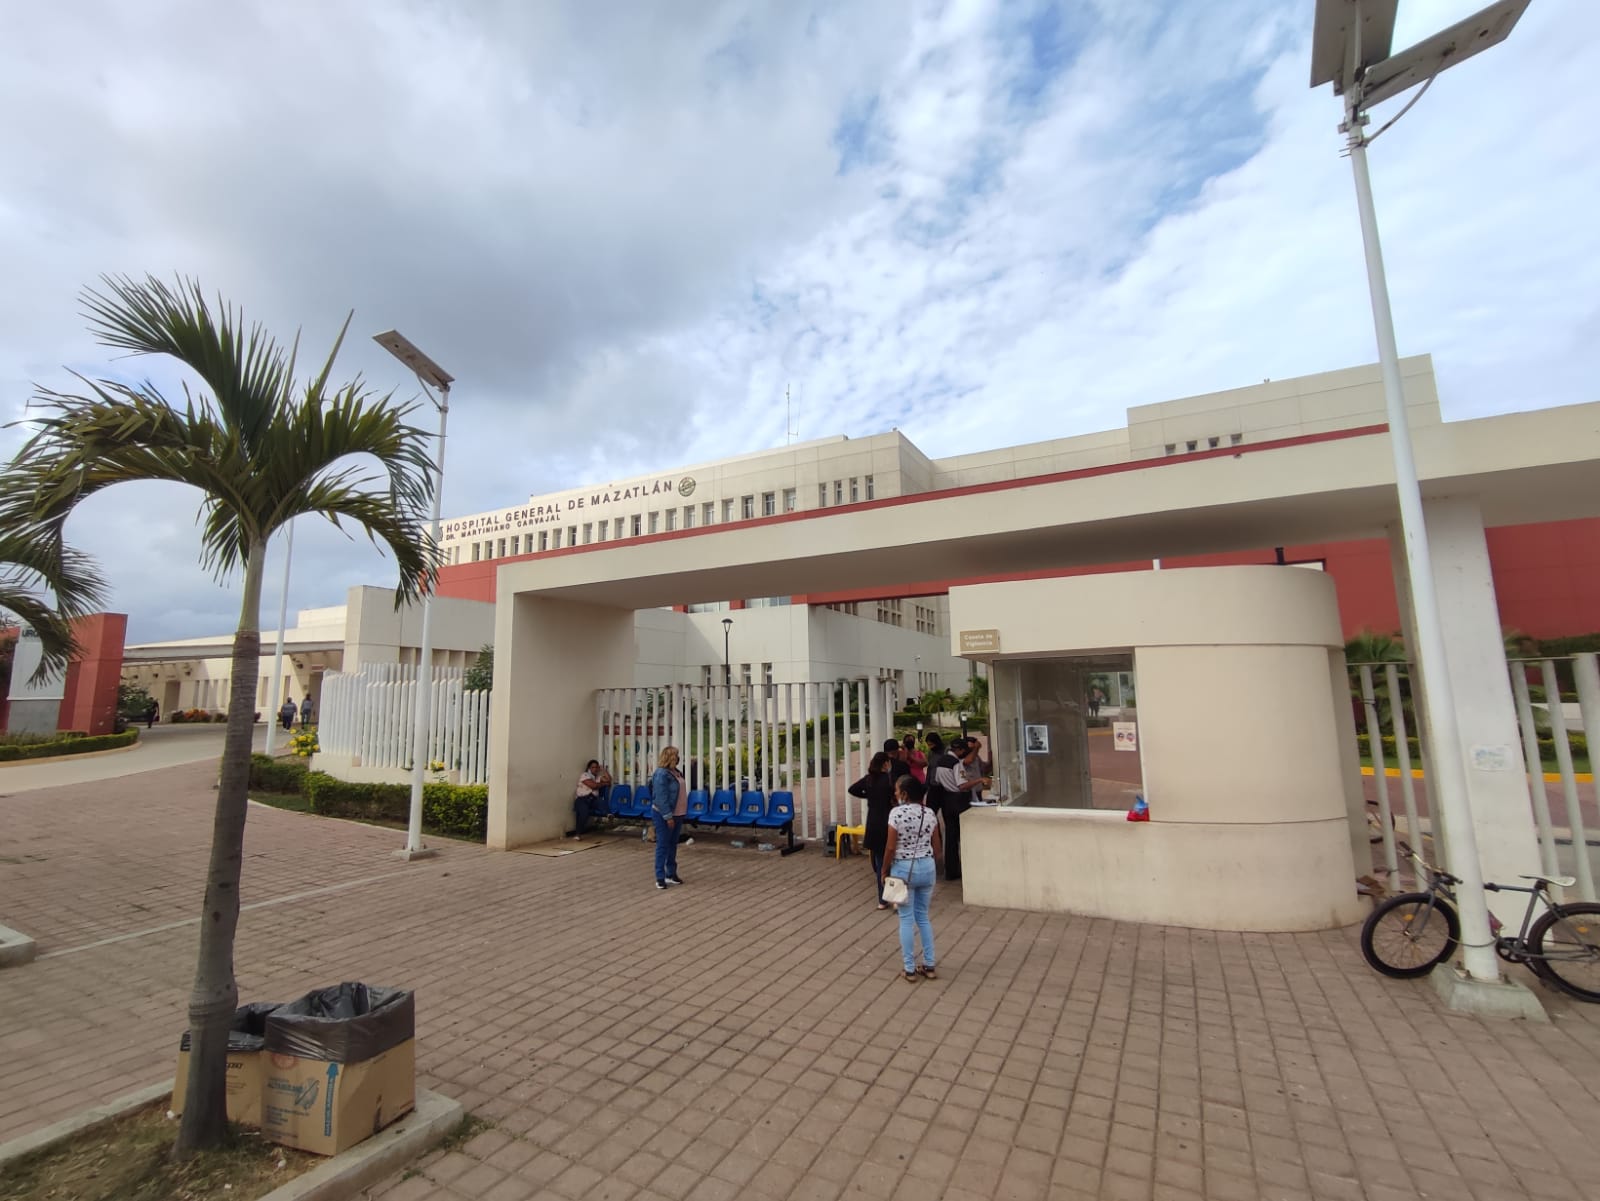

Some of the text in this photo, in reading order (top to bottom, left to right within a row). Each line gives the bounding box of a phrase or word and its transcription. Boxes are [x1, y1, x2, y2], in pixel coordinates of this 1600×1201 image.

[446, 480, 672, 533] HOSPITAL GENERAL DE MAZATLÁN
[517, 514, 561, 528] CARVAJAL
